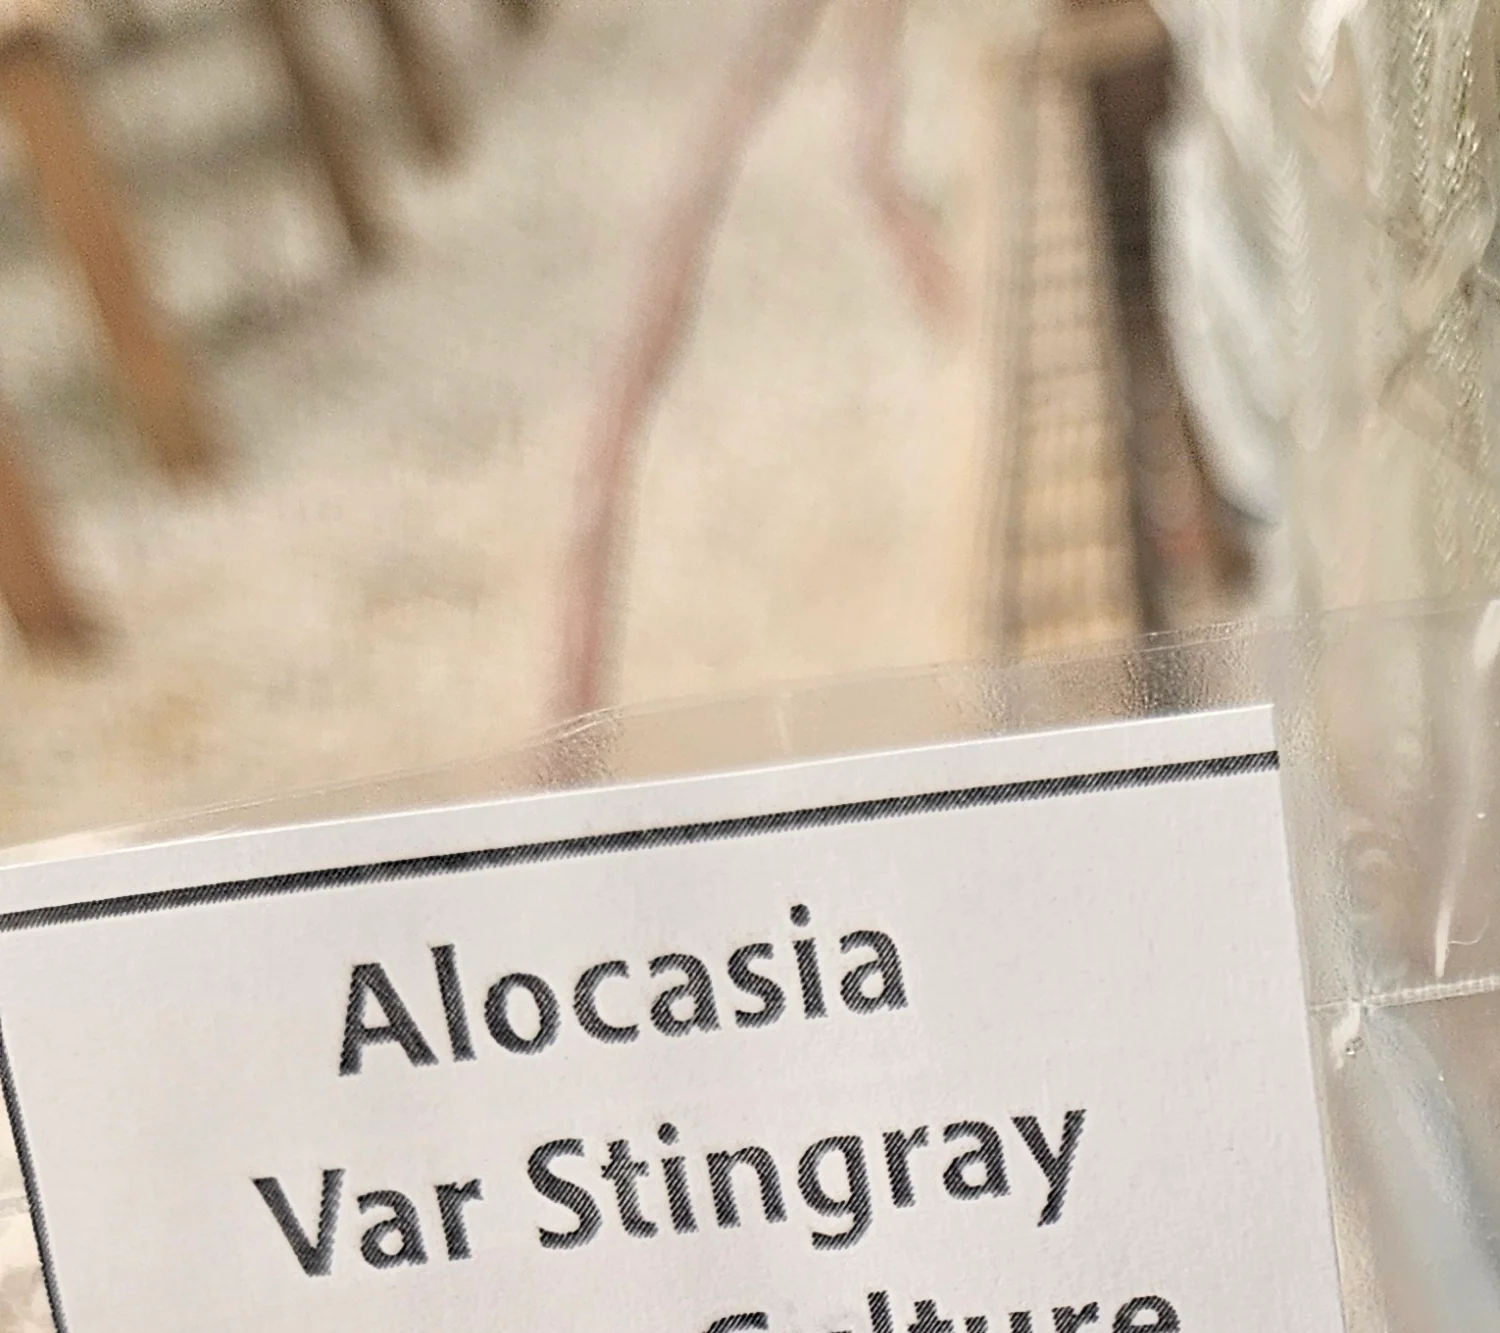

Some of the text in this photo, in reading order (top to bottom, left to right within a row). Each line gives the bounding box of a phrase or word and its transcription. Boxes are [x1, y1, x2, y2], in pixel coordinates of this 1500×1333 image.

[339, 904, 906, 1076] Alocasia
[253, 1109, 1086, 1276] Var Stingray
